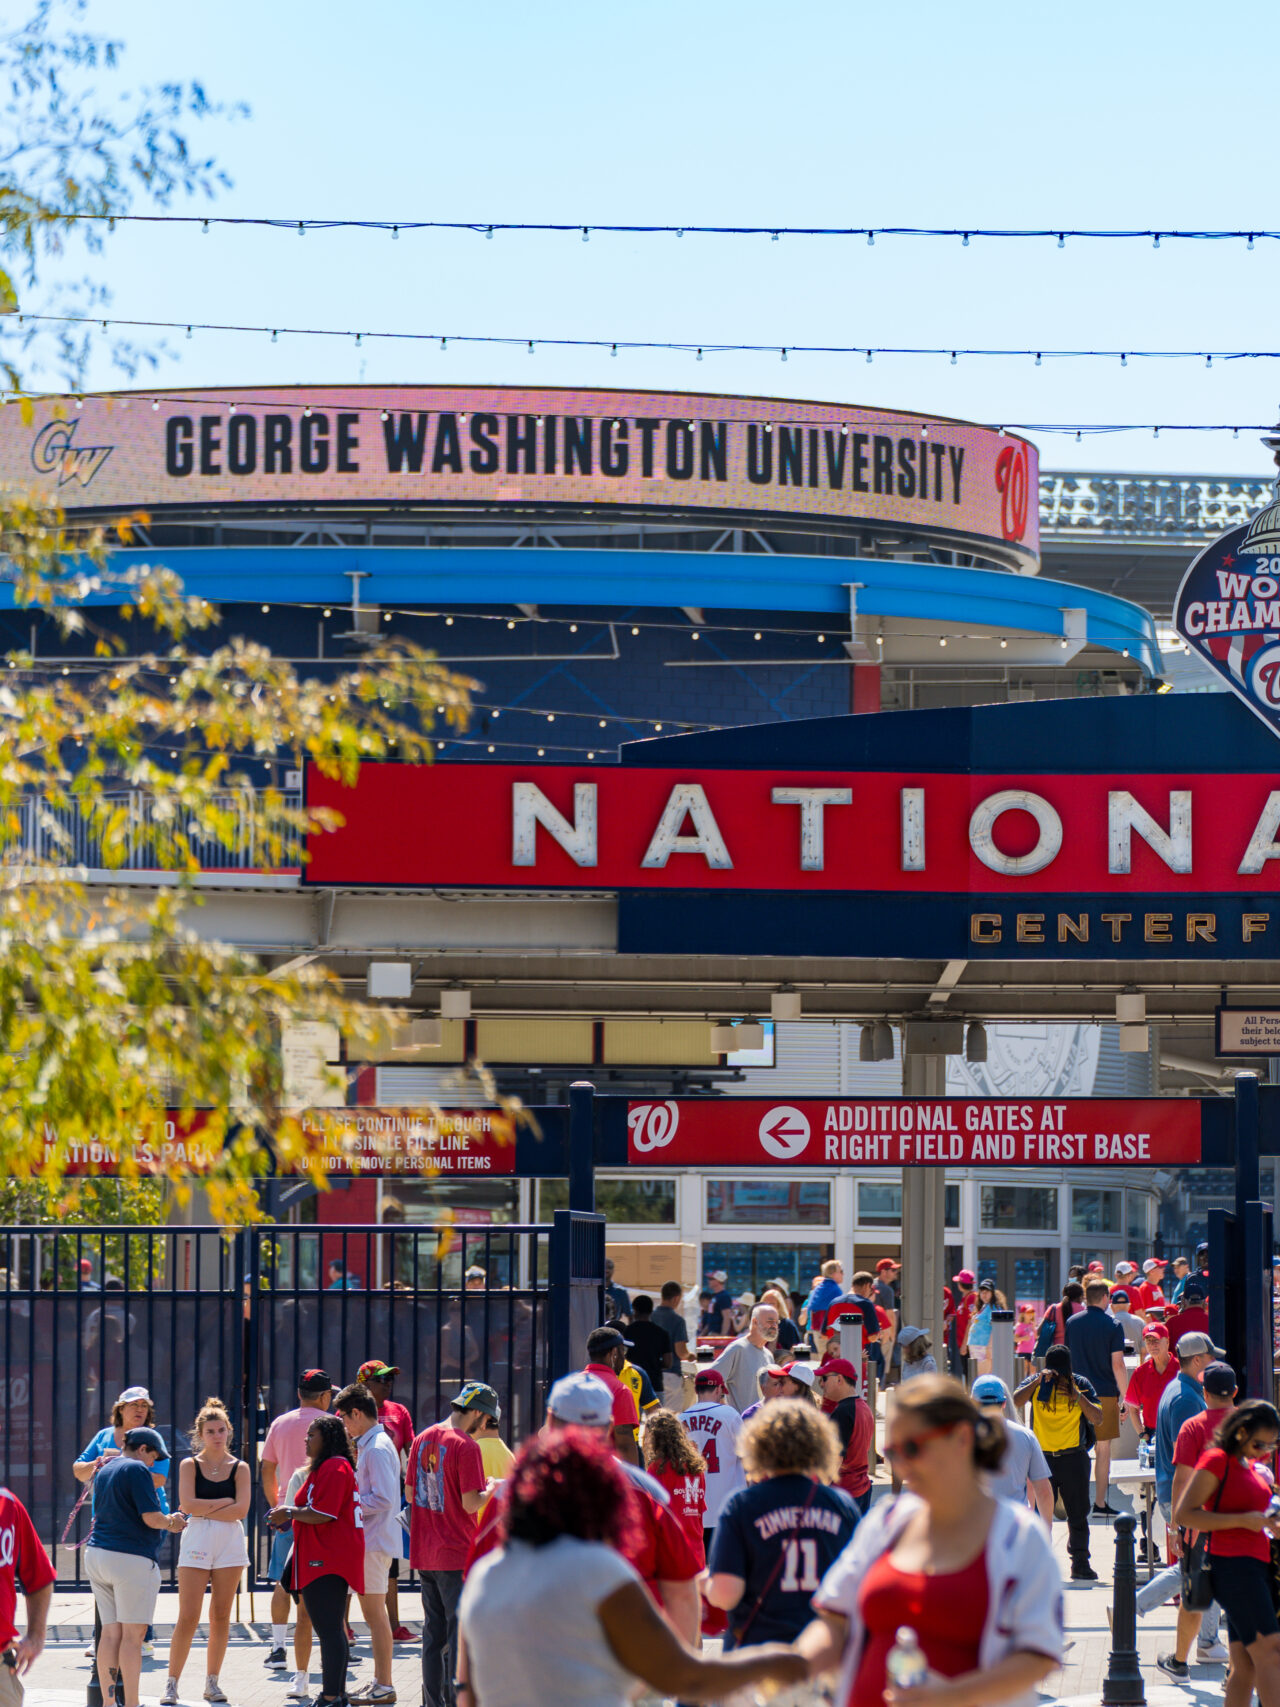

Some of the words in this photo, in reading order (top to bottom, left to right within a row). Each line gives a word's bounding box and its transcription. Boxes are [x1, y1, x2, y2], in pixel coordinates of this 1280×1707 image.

[166, 413, 360, 477] GEORGE
[384, 413, 728, 481] WASHINGTON
[747, 423, 965, 504] UNIVERSITY
[970, 912, 1217, 944] CENTER
[1241, 1026, 1262, 1035] their
[1244, 1016, 1257, 1025] All
[1240, 1037, 1271, 1047] subject
[823, 1105, 959, 1132] ADDITIONAL
[965, 1105, 1033, 1131] GATES
[1040, 1105, 1067, 1131] AT
[406, 1135, 435, 1150] FILE
[440, 1135, 470, 1150] LINE
[825, 1134, 893, 1161] RIGHT
[899, 1134, 964, 1160] FIELD
[970, 1134, 1016, 1160] AND
[1023, 1133, 1088, 1160] FIRST
[1094, 1133, 1151, 1160] BASE
[44, 1143, 153, 1163] NATIONLS
[395, 1156, 454, 1169] PERSONAL
[457, 1156, 491, 1169] ITEMS
[781, 1539, 819, 1592] 11
